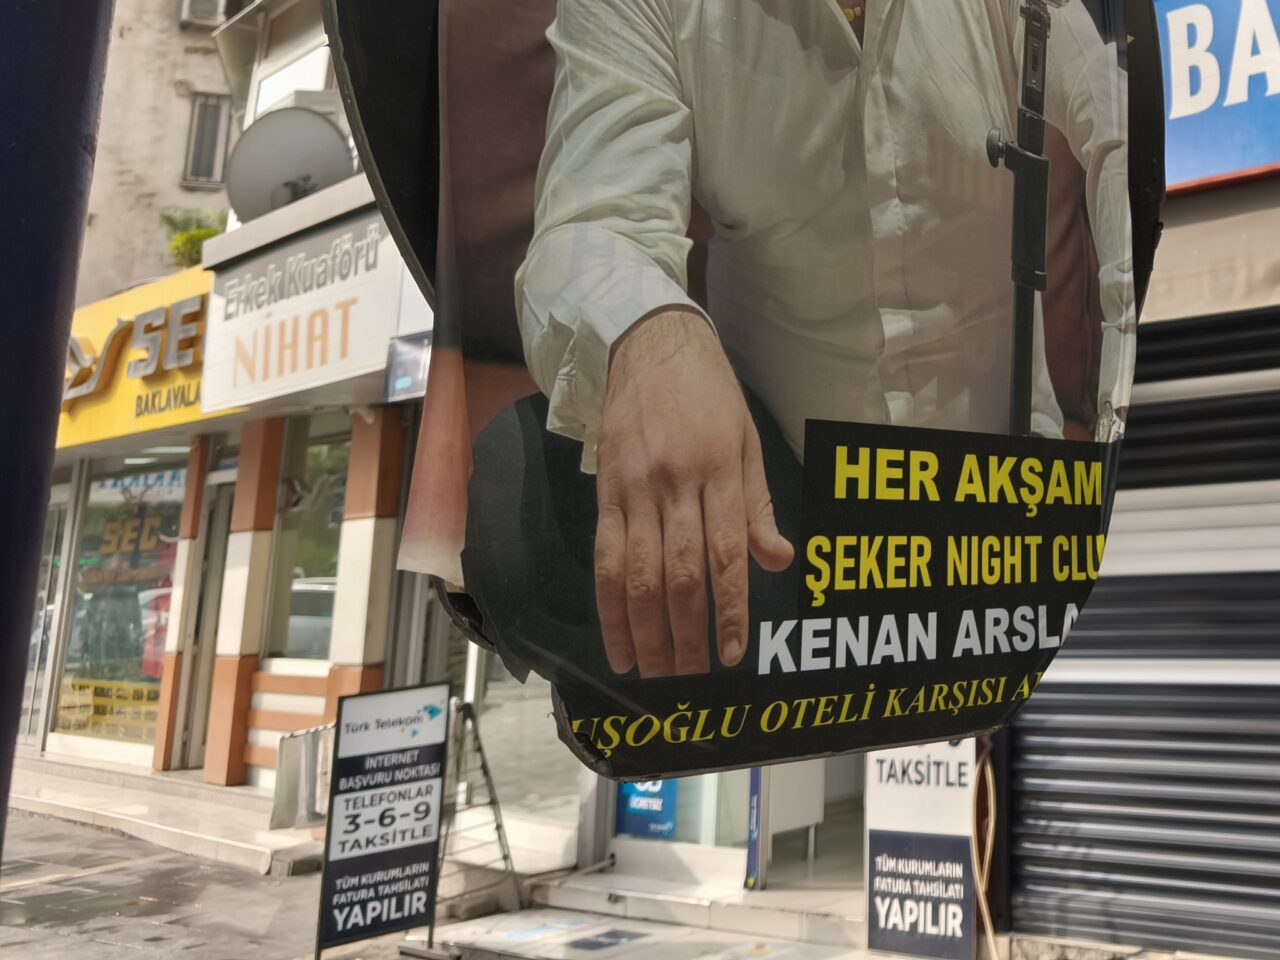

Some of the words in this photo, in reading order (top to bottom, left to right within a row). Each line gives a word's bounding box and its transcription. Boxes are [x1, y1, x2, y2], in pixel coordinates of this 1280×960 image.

[224, 264, 282, 321] Erkek
[286, 222, 380, 299] Kuaförü
[127, 293, 208, 380] SE
[233, 296, 359, 388] NİHAT
[834, 445, 940, 502] HER
[954, 453, 1102, 517] AKŞAM
[805, 535, 932, 607] ŞEKER
[947, 535, 1042, 587] NIGHT
[758, 611, 938, 676] KENAN
[759, 683, 876, 730] OTELİ
[880, 676, 1007, 719] KARŞISI
[344, 721, 371, 734] Türk
[375, 715, 424, 730] Telekom
[338, 771, 392, 792] BAŞVURU
[393, 761, 441, 780] NOKTASI
[876, 754, 968, 787] TAKSİTLE
[345, 784, 434, 811] TELEFONLAR
[343, 801, 431, 834] 3-6-9
[338, 824, 433, 854] TAKSİTLE
[335, 874, 360, 890] TÜM
[361, 861, 430, 886] KURUMLARIN
[873, 853, 896, 872] TÜM
[897, 856, 963, 879] KURUMLARIN
[332, 887, 375, 906] FATURA
[873, 876, 912, 894] FATURA
[333, 891, 427, 932] YAPILIR
[874, 897, 963, 938] YAPILIR
